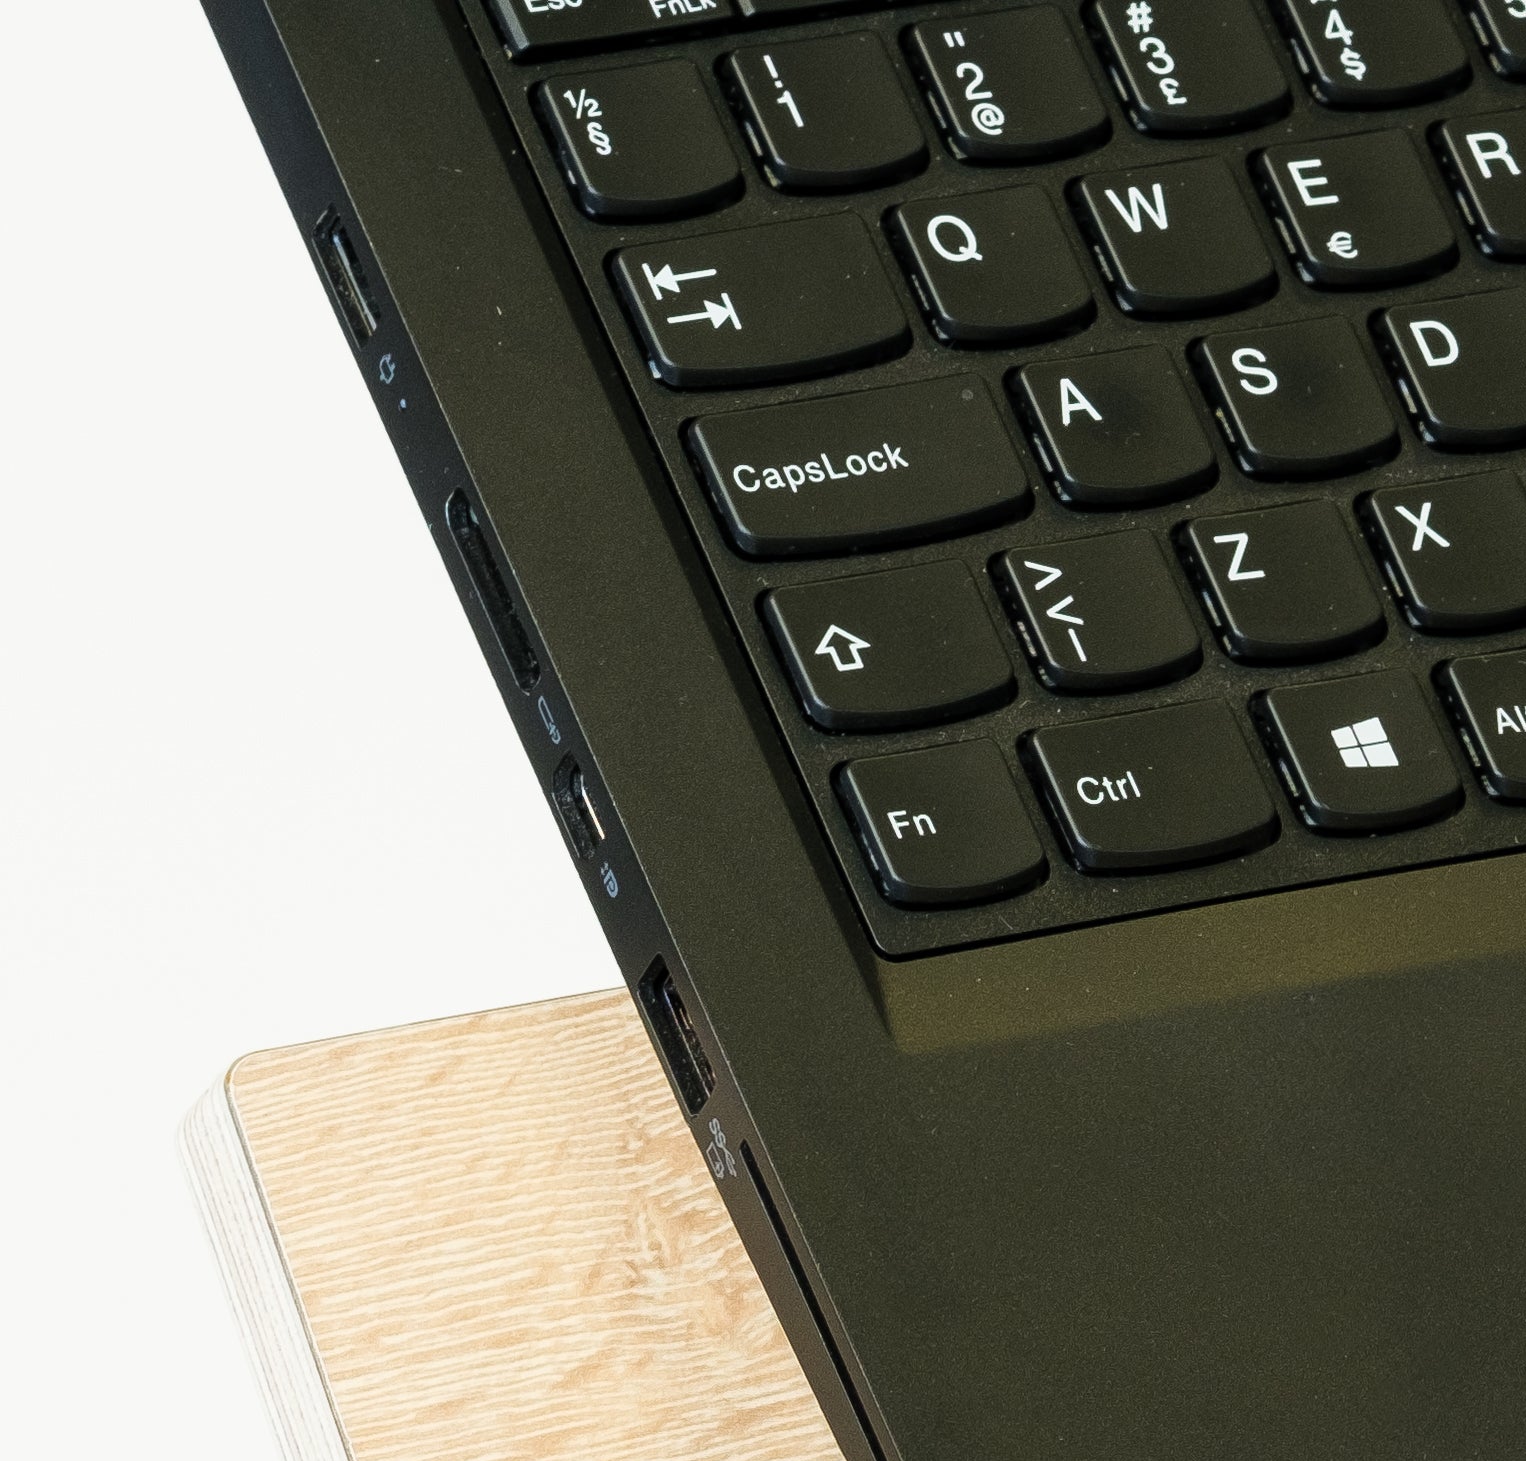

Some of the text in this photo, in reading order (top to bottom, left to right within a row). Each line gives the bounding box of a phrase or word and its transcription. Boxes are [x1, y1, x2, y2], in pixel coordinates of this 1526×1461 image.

[1324, 8, 1354, 46] 4
[1139, 36, 1175, 75] 3
[1339, 47, 1367, 81] $
[956, 62, 994, 101] 2
[1158, 77, 1188, 105] £
[776, 90, 805, 128] 1
[970, 102, 1005, 136] @
[585, 121, 613, 156] §
[1465, 131, 1522, 179] R
[1287, 158, 1340, 207] E
[1104, 182, 1169, 234] W
[926, 214, 983, 263] Q
[1326, 231, 1359, 259] €
[1409, 320, 1460, 367] D
[1231, 347, 1279, 396] S
[1059, 377, 1103, 427] A
[732, 442, 911, 494] CapsLock
[1394, 501, 1451, 552] X
[1213, 532, 1266, 582] Z
[1075, 770, 1142, 805] Ctrl
[886, 809, 938, 840] Fn
